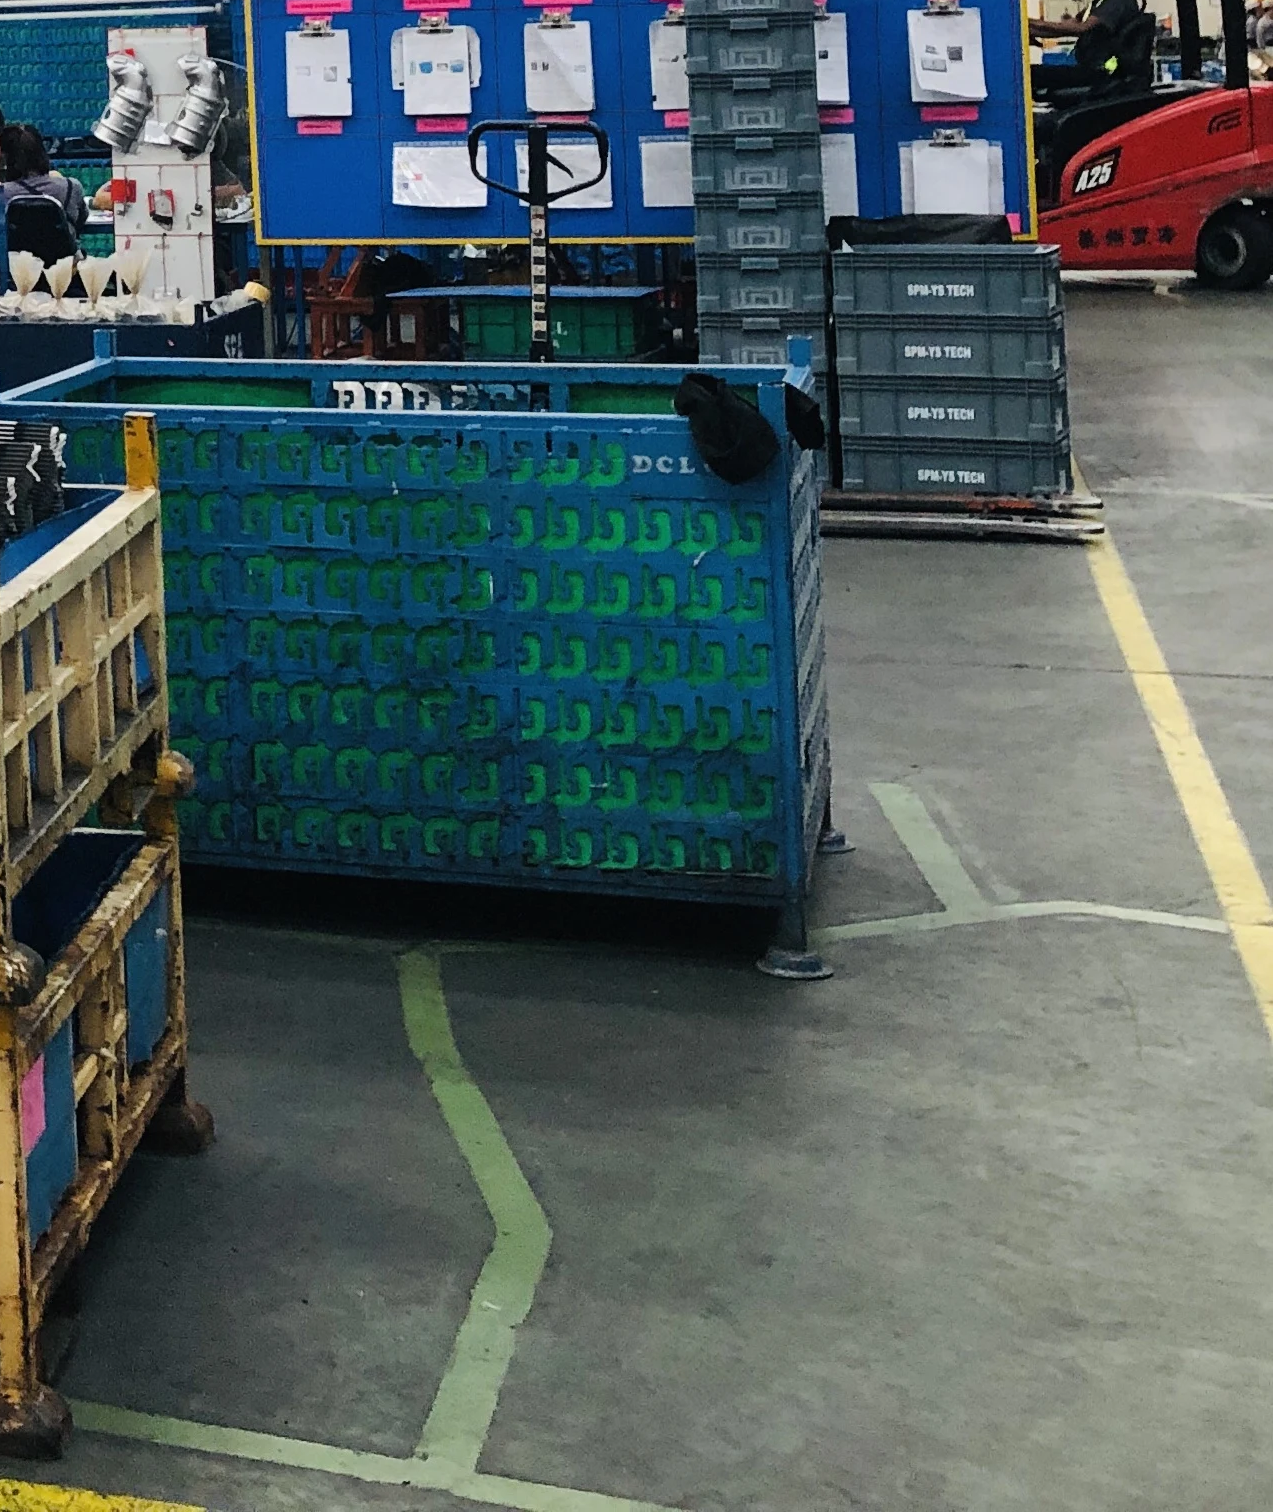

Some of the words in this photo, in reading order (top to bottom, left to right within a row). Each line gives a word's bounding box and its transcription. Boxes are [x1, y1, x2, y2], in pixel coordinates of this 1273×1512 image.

[1074, 160, 1114, 193] A25
[946, 284, 975, 297] TECH
[943, 345, 972, 359] TECH
[947, 407, 975, 420] TECH
[632, 455, 696, 474] DCL
[957, 471, 986, 484] TECH
